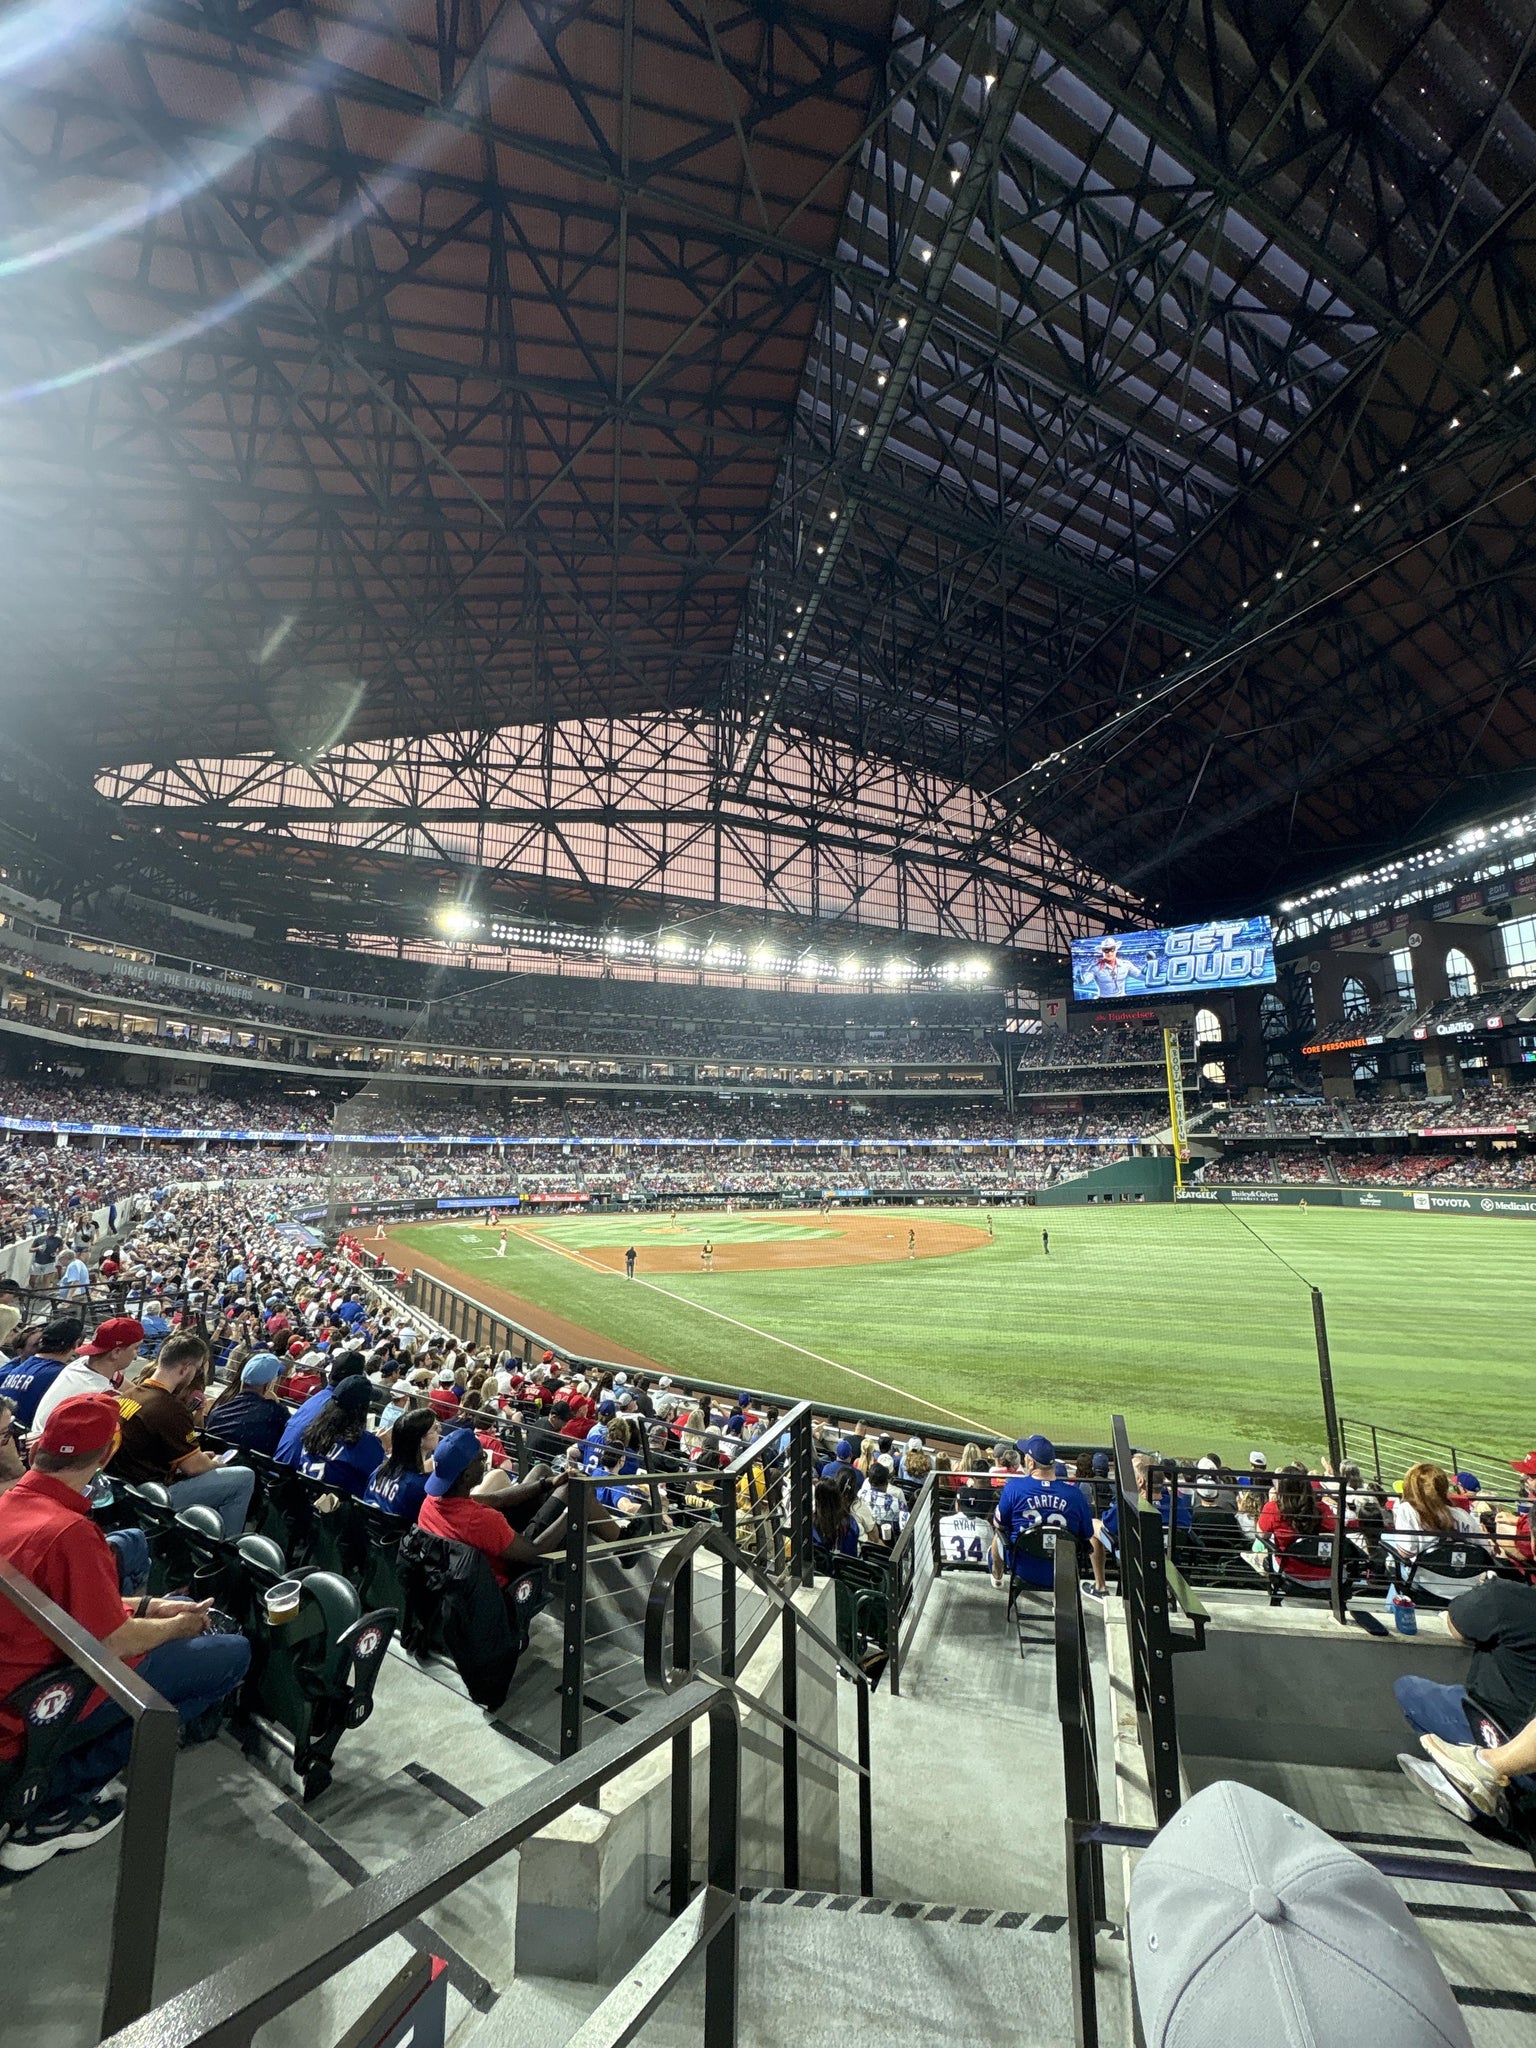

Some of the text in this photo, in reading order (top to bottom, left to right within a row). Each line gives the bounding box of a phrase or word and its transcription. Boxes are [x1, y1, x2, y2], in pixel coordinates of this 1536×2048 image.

[1165, 926, 1242, 957] GET
[1410, 935, 1420, 945] 34
[1146, 948, 1266, 988] LOUD!
[113, 962, 253, 1000] HOME OF THE TEXAS RANGERS
[1108, 1011, 1155, 1021] Budweiser
[1436, 1021, 1475, 1035] QuikTrip
[1302, 1045, 1320, 1054] CORE
[1321, 1037, 1367, 1052] PERSONNEL
[1176, 1191, 1217, 1199] SEATGEEK
[1430, 1198, 1471, 1208] TOYOTA
[1495, 1201, 1530, 1211] Medical
[1026, 1494, 1067, 1512] CARTER
[953, 1519, 976, 1532] RYAN
[950, 1535, 984, 1561] 34
[355, 1705, 365, 1719] 10
[23, 1785, 38, 1806] 11
